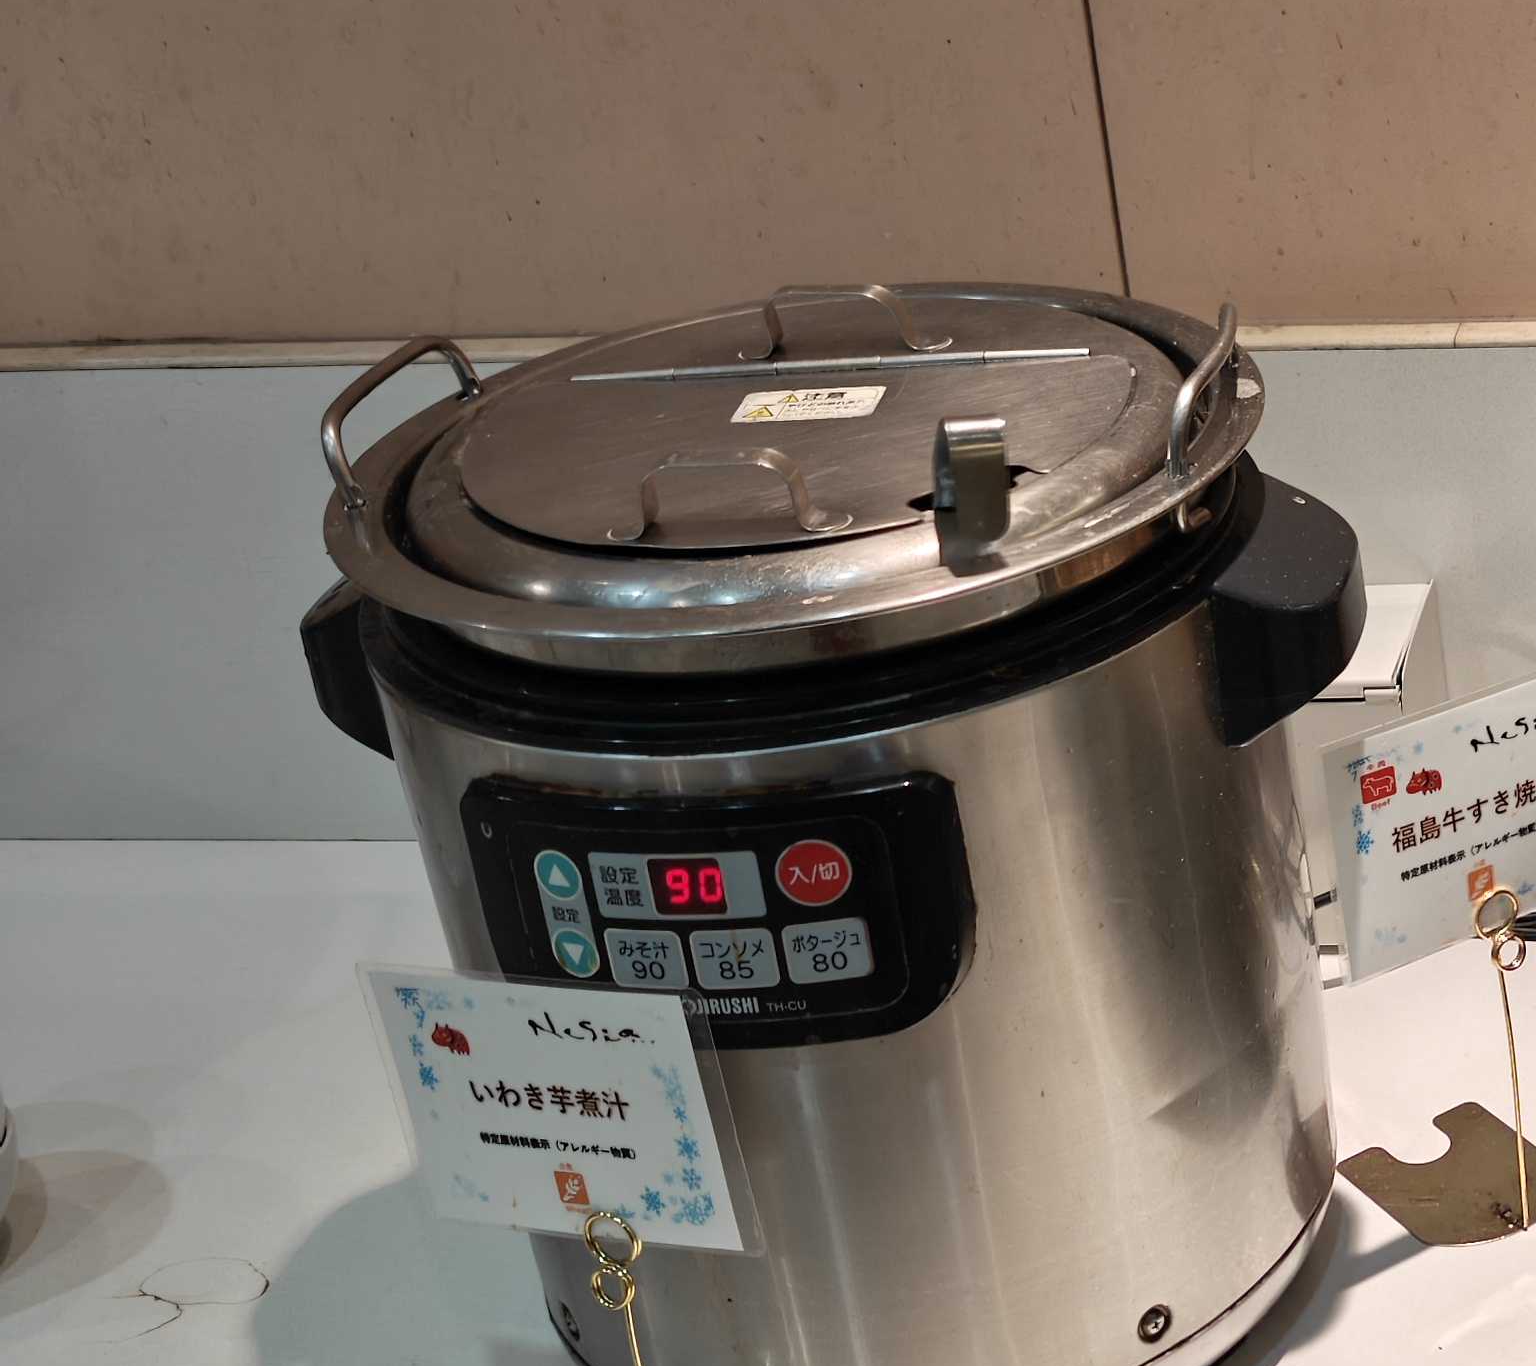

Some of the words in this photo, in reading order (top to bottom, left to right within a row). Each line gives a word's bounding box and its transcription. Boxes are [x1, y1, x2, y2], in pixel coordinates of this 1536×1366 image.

[598, 865, 640, 885] 設定
[788, 861, 841, 886] 入/切
[664, 866, 725, 906] 90
[604, 889, 645, 908] 温度
[551, 906, 581, 924] 設定
[618, 940, 670, 960] みそ汁
[698, 939, 765, 959] コンソメ
[791, 930, 862, 954] ポタージュ
[631, 961, 666, 980] 90
[718, 960, 755, 980] 85
[811, 950, 848, 973] 80
[468, 1079, 631, 1122] いわき芋煮汁
